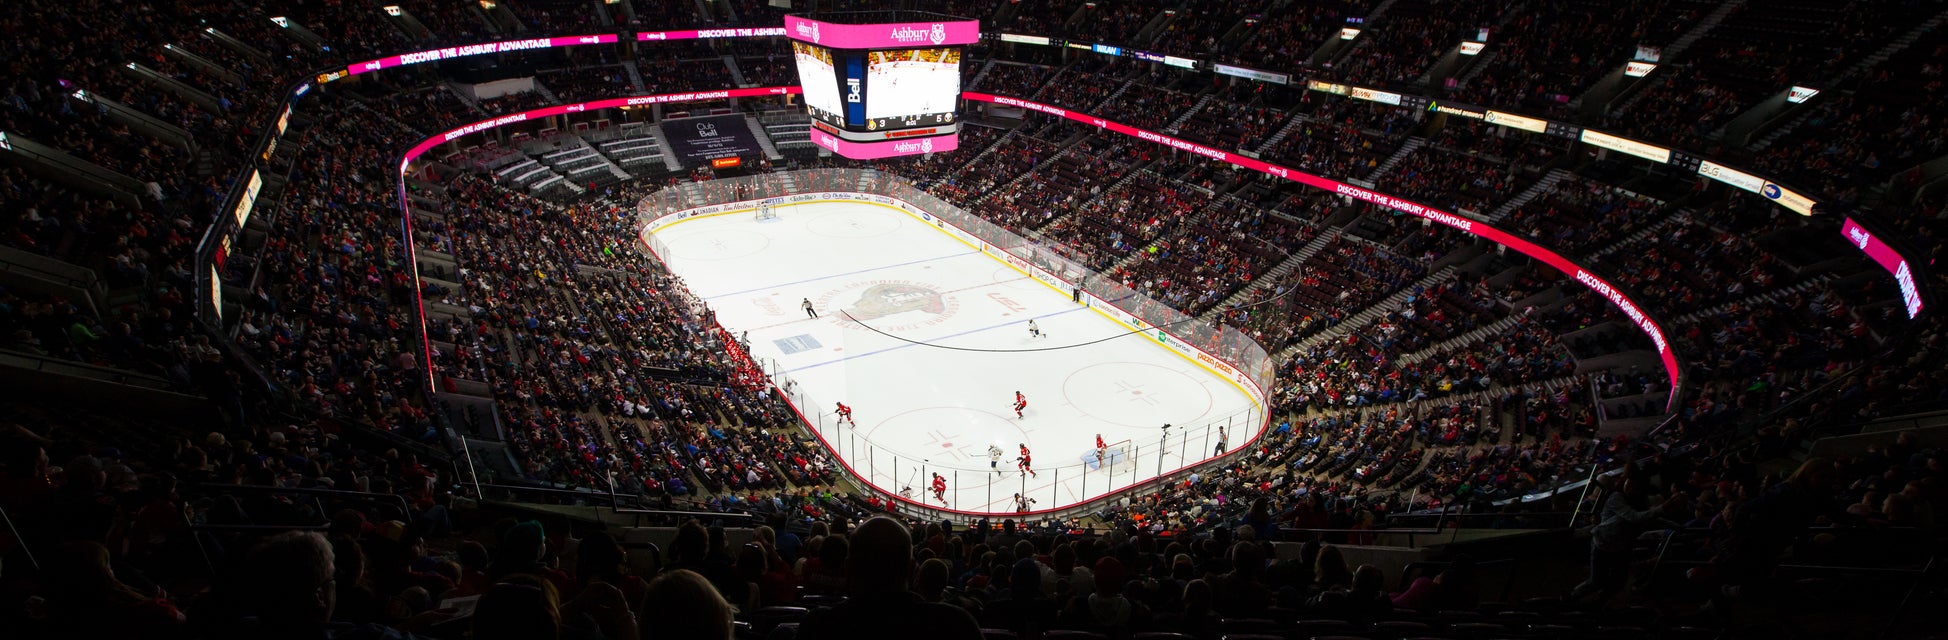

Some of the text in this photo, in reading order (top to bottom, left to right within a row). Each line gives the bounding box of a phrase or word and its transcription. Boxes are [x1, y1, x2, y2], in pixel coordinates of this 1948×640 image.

[698, 29, 736, 38] DISCOVER
[737, 28, 752, 37] THE
[891, 26, 929, 41] Ashbury
[400, 38, 551, 65] DISCOVER THE ASHBURY ADVANTAGE
[627, 91, 729, 105] DISCOVER THE ASHBURY ADVANTAGE
[847, 78, 860, 103] Bell
[879, 119, 886, 128] 3
[936, 114, 942, 122] 5
[444, 129, 465, 141] DISCOVER
[464, 126, 474, 134] THE
[495, 113, 527, 126] ADVANTAGE
[696, 122, 715, 131] Club
[699, 129, 718, 138] Bell
[1138, 130, 1226, 160] DISCOVER THE ASHBURY ADVANTAGE
[1700, 163, 1719, 177] BLG
[1337, 184, 1472, 231] DISCOVER THE ASHBURY ADVANTAGE
[1577, 269, 1611, 297] DISCOVER
[1609, 289, 1623, 306] THE
[1619, 298, 1645, 325] ASHBURY
[1197, 352, 1233, 375] pizza pizza
